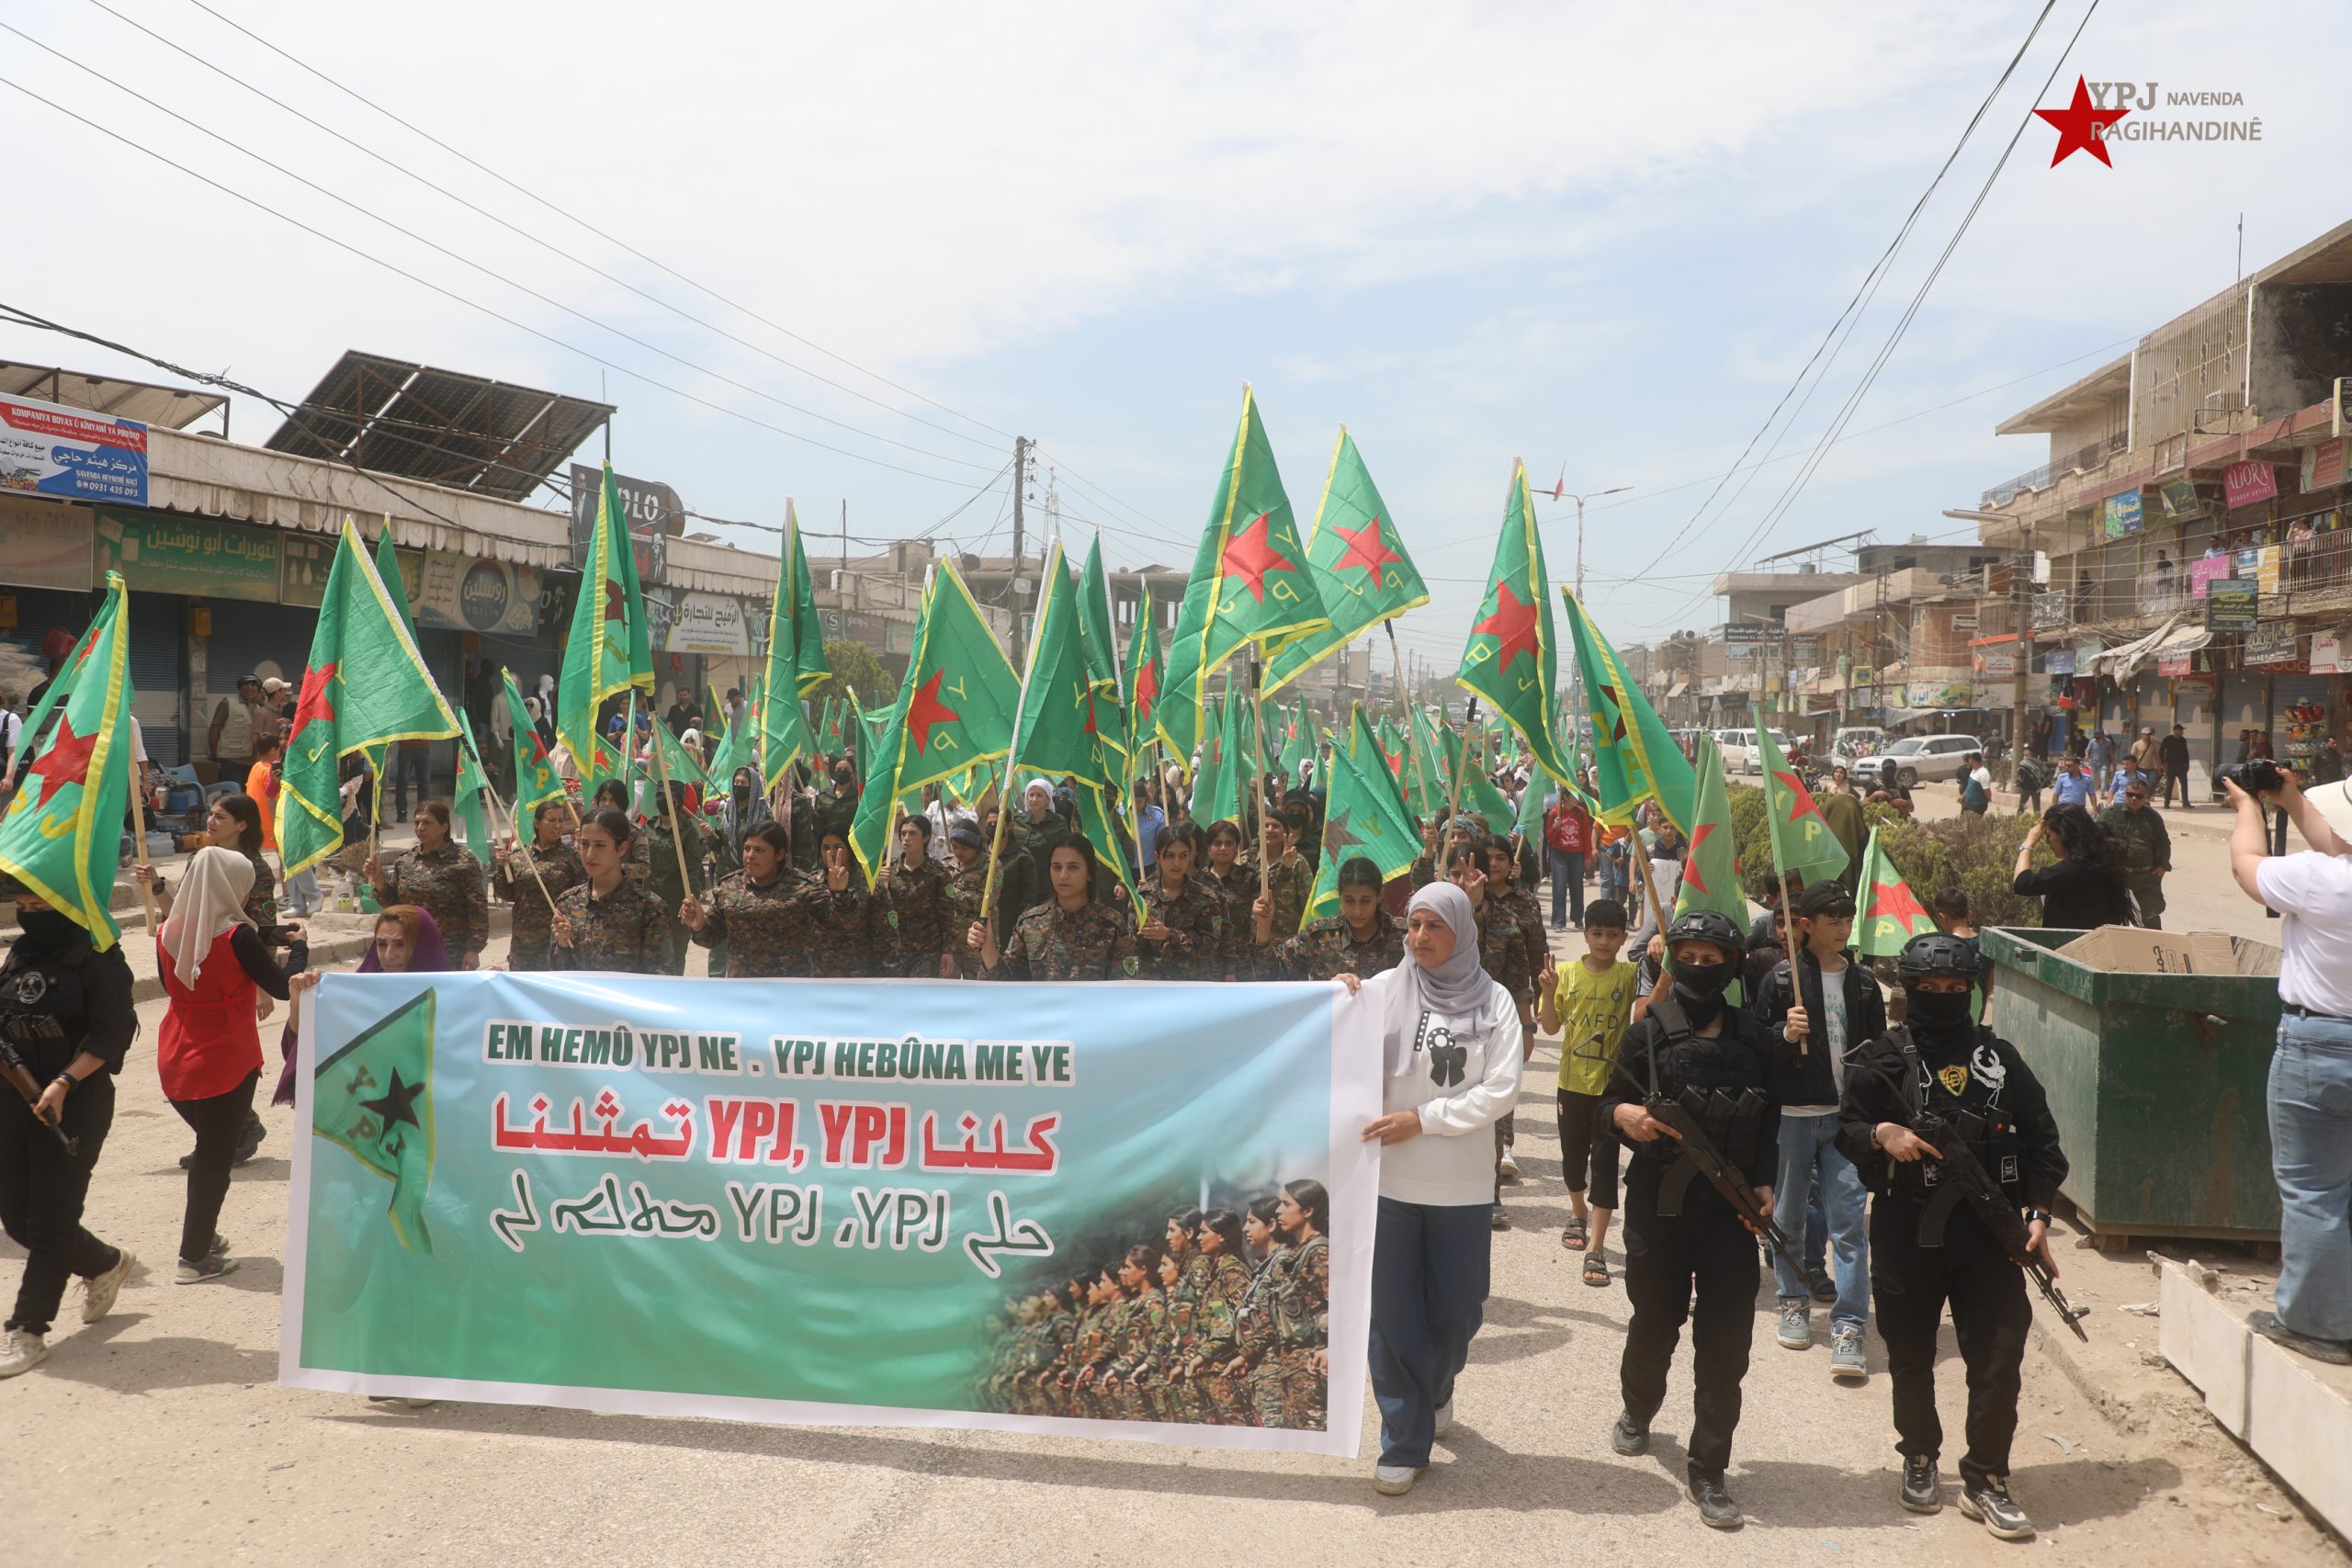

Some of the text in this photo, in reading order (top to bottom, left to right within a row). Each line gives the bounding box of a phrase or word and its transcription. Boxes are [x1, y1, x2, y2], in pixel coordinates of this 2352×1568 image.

[11, 407, 51, 424] KOMPANIYA
[51, 415, 74, 428] BOYAX
[107, 426, 117, 436] YA
[52, 451, 83, 465] حاجي
[110, 457, 137, 475] مركز
[89, 481, 139, 497] 0931 435 093
[146, 524, 276, 563] تنويرات أبو نوشين
[464, 574, 506, 604] روسلين
[683, 603, 714, 623] للتجارة
[1464, 642, 1491, 663] P
[537, 768, 549, 789] P
[1774, 790, 1786, 810] Y
[1805, 820, 1822, 841] P
[1875, 920, 1895, 938] P
[488, 1023, 533, 1061] EM
[540, 1025, 633, 1065] HEMÛ
[639, 1032, 692, 1070] YPJ
[698, 1036, 738, 1072] NE
[774, 1039, 827, 1077] YPJ
[834, 1036, 967, 1080] HEBÛNA
[975, 1044, 1024, 1082] ME
[1031, 1045, 1070, 1082] YE
[346, 1065, 377, 1096] Y
[347, 1115, 377, 1141] P
[496, 1091, 1057, 1171] كلنا YPJ YPJ, تمثلنا
[730, 1187, 818, 1241] YPJ
